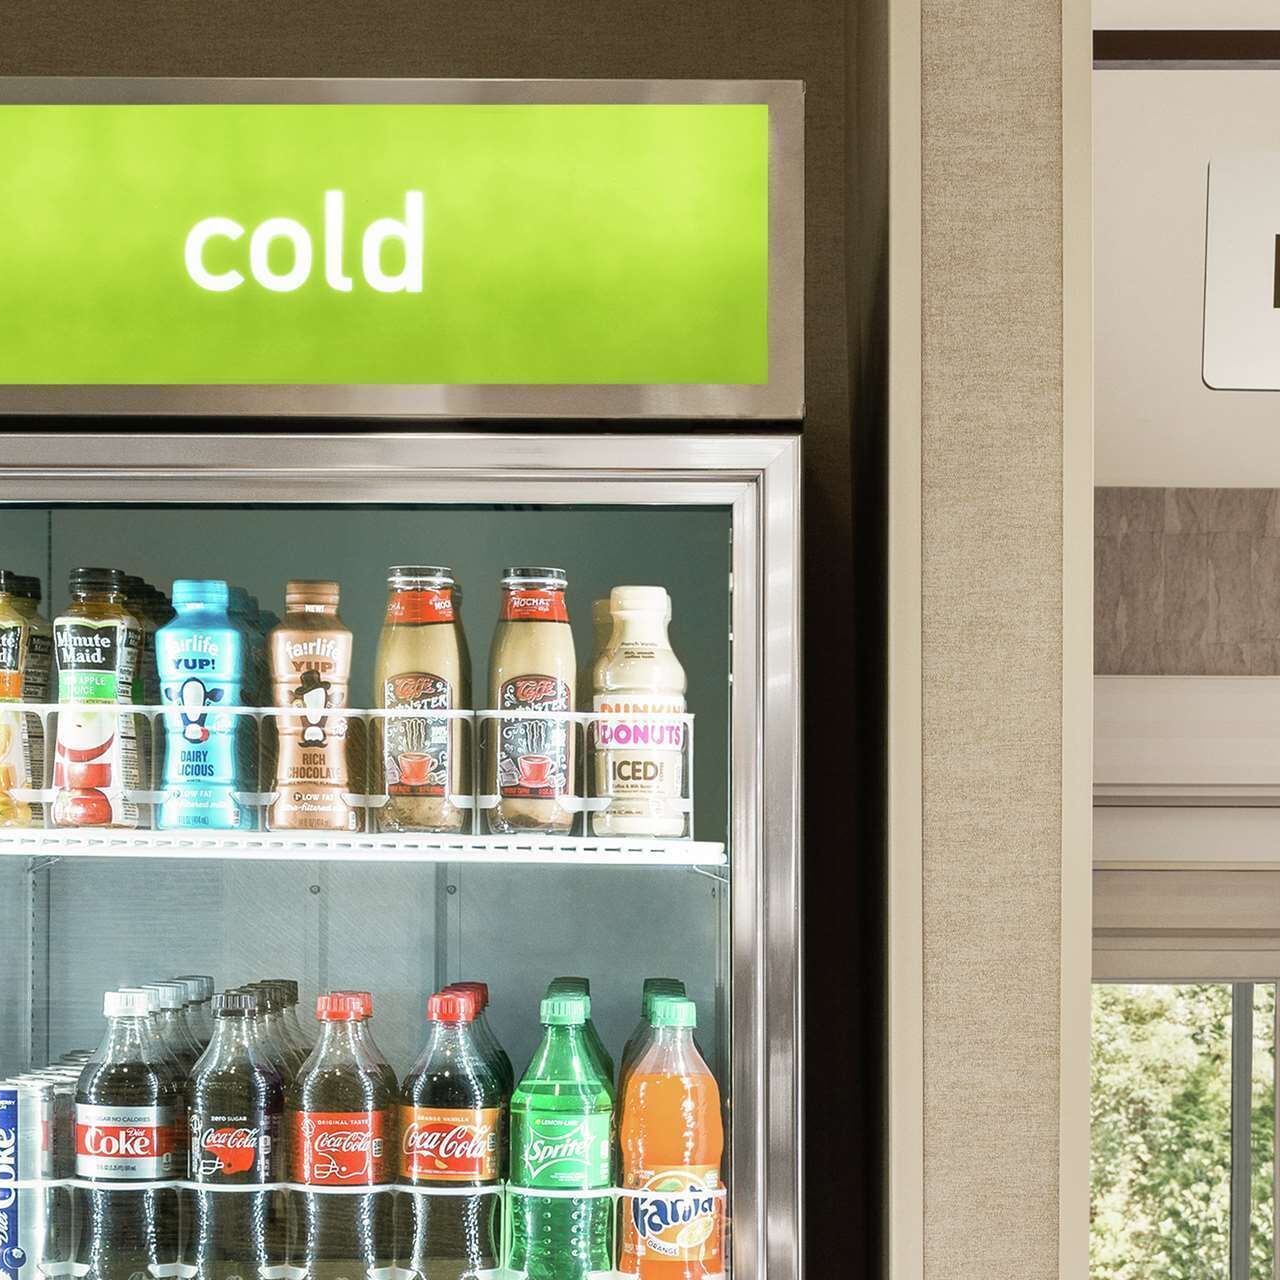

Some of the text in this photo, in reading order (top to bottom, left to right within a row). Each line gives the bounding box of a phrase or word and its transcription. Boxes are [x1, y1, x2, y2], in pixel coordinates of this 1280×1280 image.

[183, 193, 423, 295] cold
[173, 659, 215, 670] YUP!
[600, 725, 680, 744] DONUTS
[181, 751, 208, 762] DAIRY
[302, 754, 326, 764] RICH
[612, 761, 658, 781] ICED
[85, 1126, 151, 1155] Coke
[201, 1128, 260, 1149] Coca-Cola
[315, 1132, 373, 1152] Coca-Cola
[403, 1123, 491, 1159] Coca-Cola
[648, 1240, 678, 1255] ORANGE
